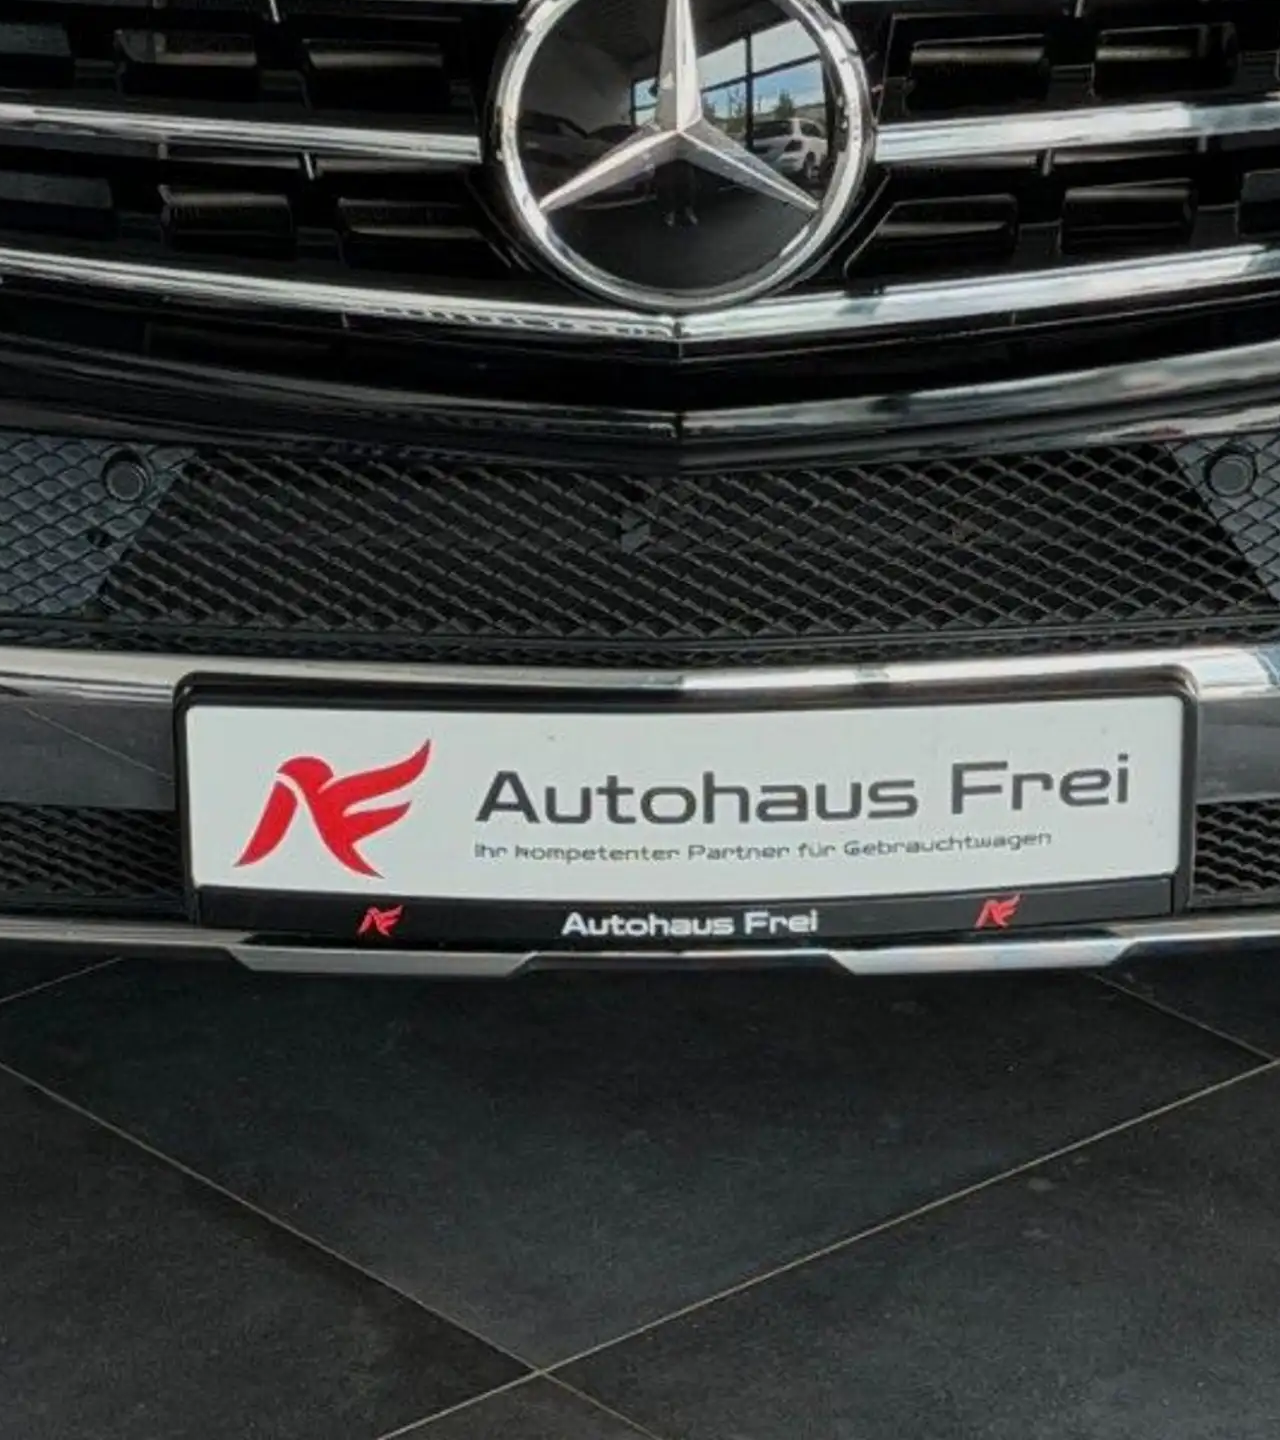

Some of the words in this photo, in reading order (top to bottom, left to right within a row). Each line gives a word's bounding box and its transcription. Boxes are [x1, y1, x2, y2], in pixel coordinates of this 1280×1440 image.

[475, 770, 919, 825] Autohaus
[950, 752, 1129, 816] Frei
[474, 842, 508, 859] Ihr
[515, 843, 681, 864] kompetenter
[688, 843, 790, 861] Partner
[797, 841, 836, 859] für
[843, 831, 1053, 857] Gebrauchtwagen
[561, 911, 736, 937] Autohaus
[743, 909, 819, 936] Frei
